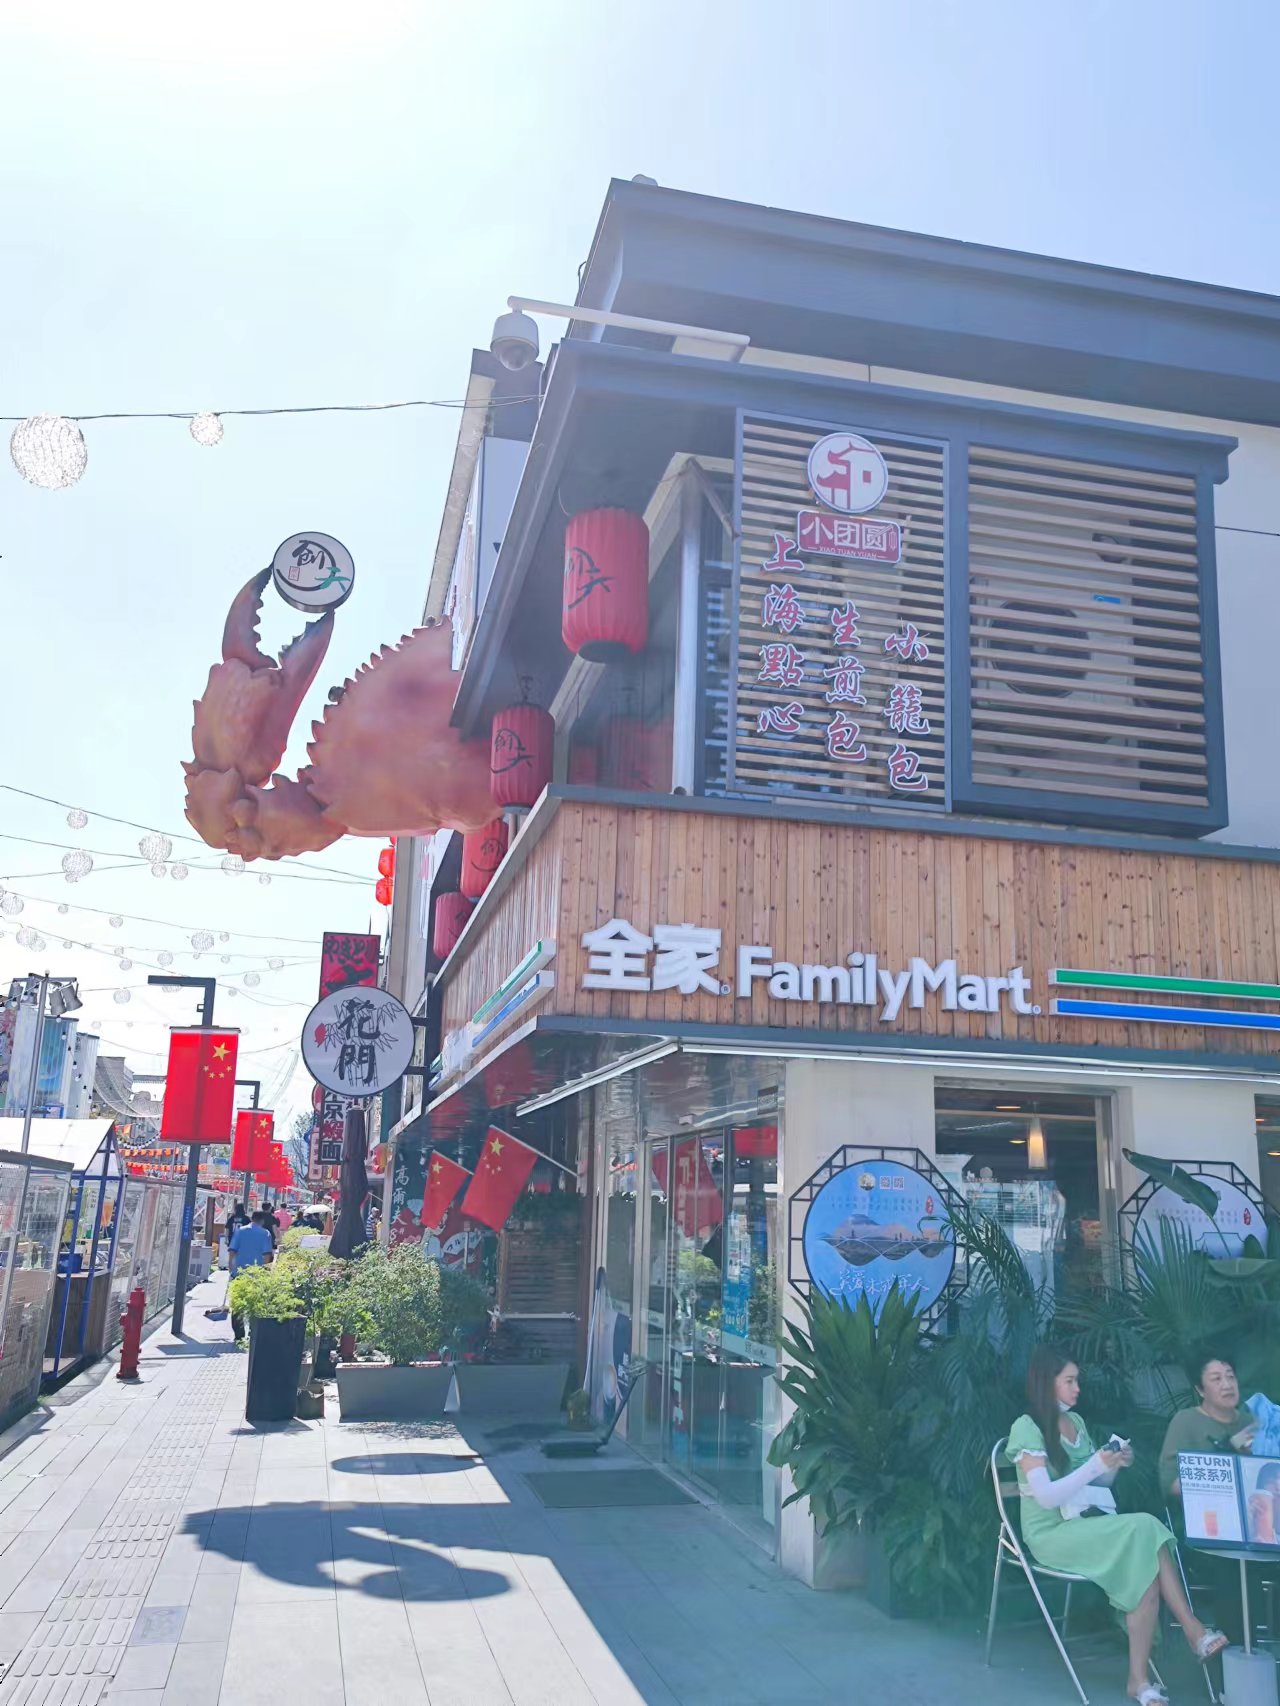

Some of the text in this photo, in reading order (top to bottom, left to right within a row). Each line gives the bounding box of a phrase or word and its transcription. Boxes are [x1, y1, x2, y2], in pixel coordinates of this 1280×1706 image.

[801, 516, 888, 552] 小团圆
[837, 548, 856, 557] TUAN
[757, 532, 805, 736] 上海點心
[823, 599, 867, 763] 生煎包
[883, 622, 931, 793] 小籠包
[581, 917, 722, 996] 全家
[736, 944, 1034, 1022] FamilyMart
[1179, 1455, 1231, 1467] RETURN
[1180, 1466, 1233, 1483] 纯茶系列
